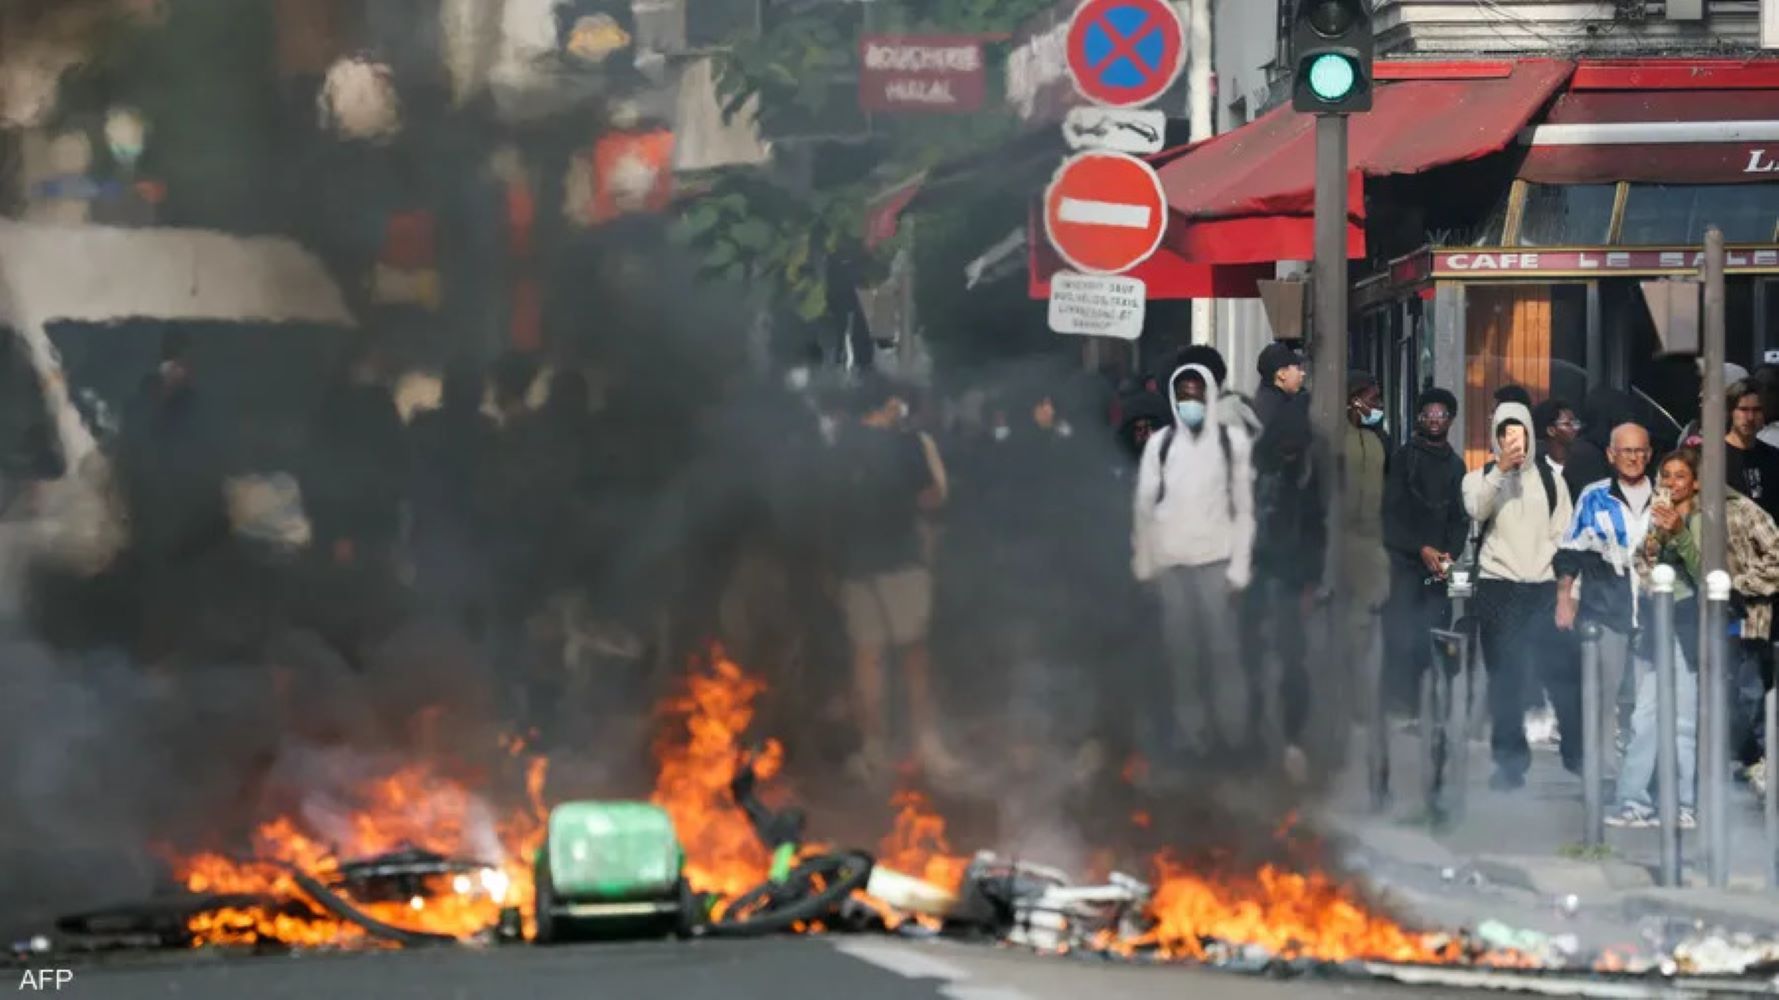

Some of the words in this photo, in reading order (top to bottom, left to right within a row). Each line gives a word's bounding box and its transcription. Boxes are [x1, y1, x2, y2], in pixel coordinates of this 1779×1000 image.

[1743, 149, 1779, 172] L
[1447, 254, 1539, 269] CAFE
[1579, 252, 1631, 268] LE
